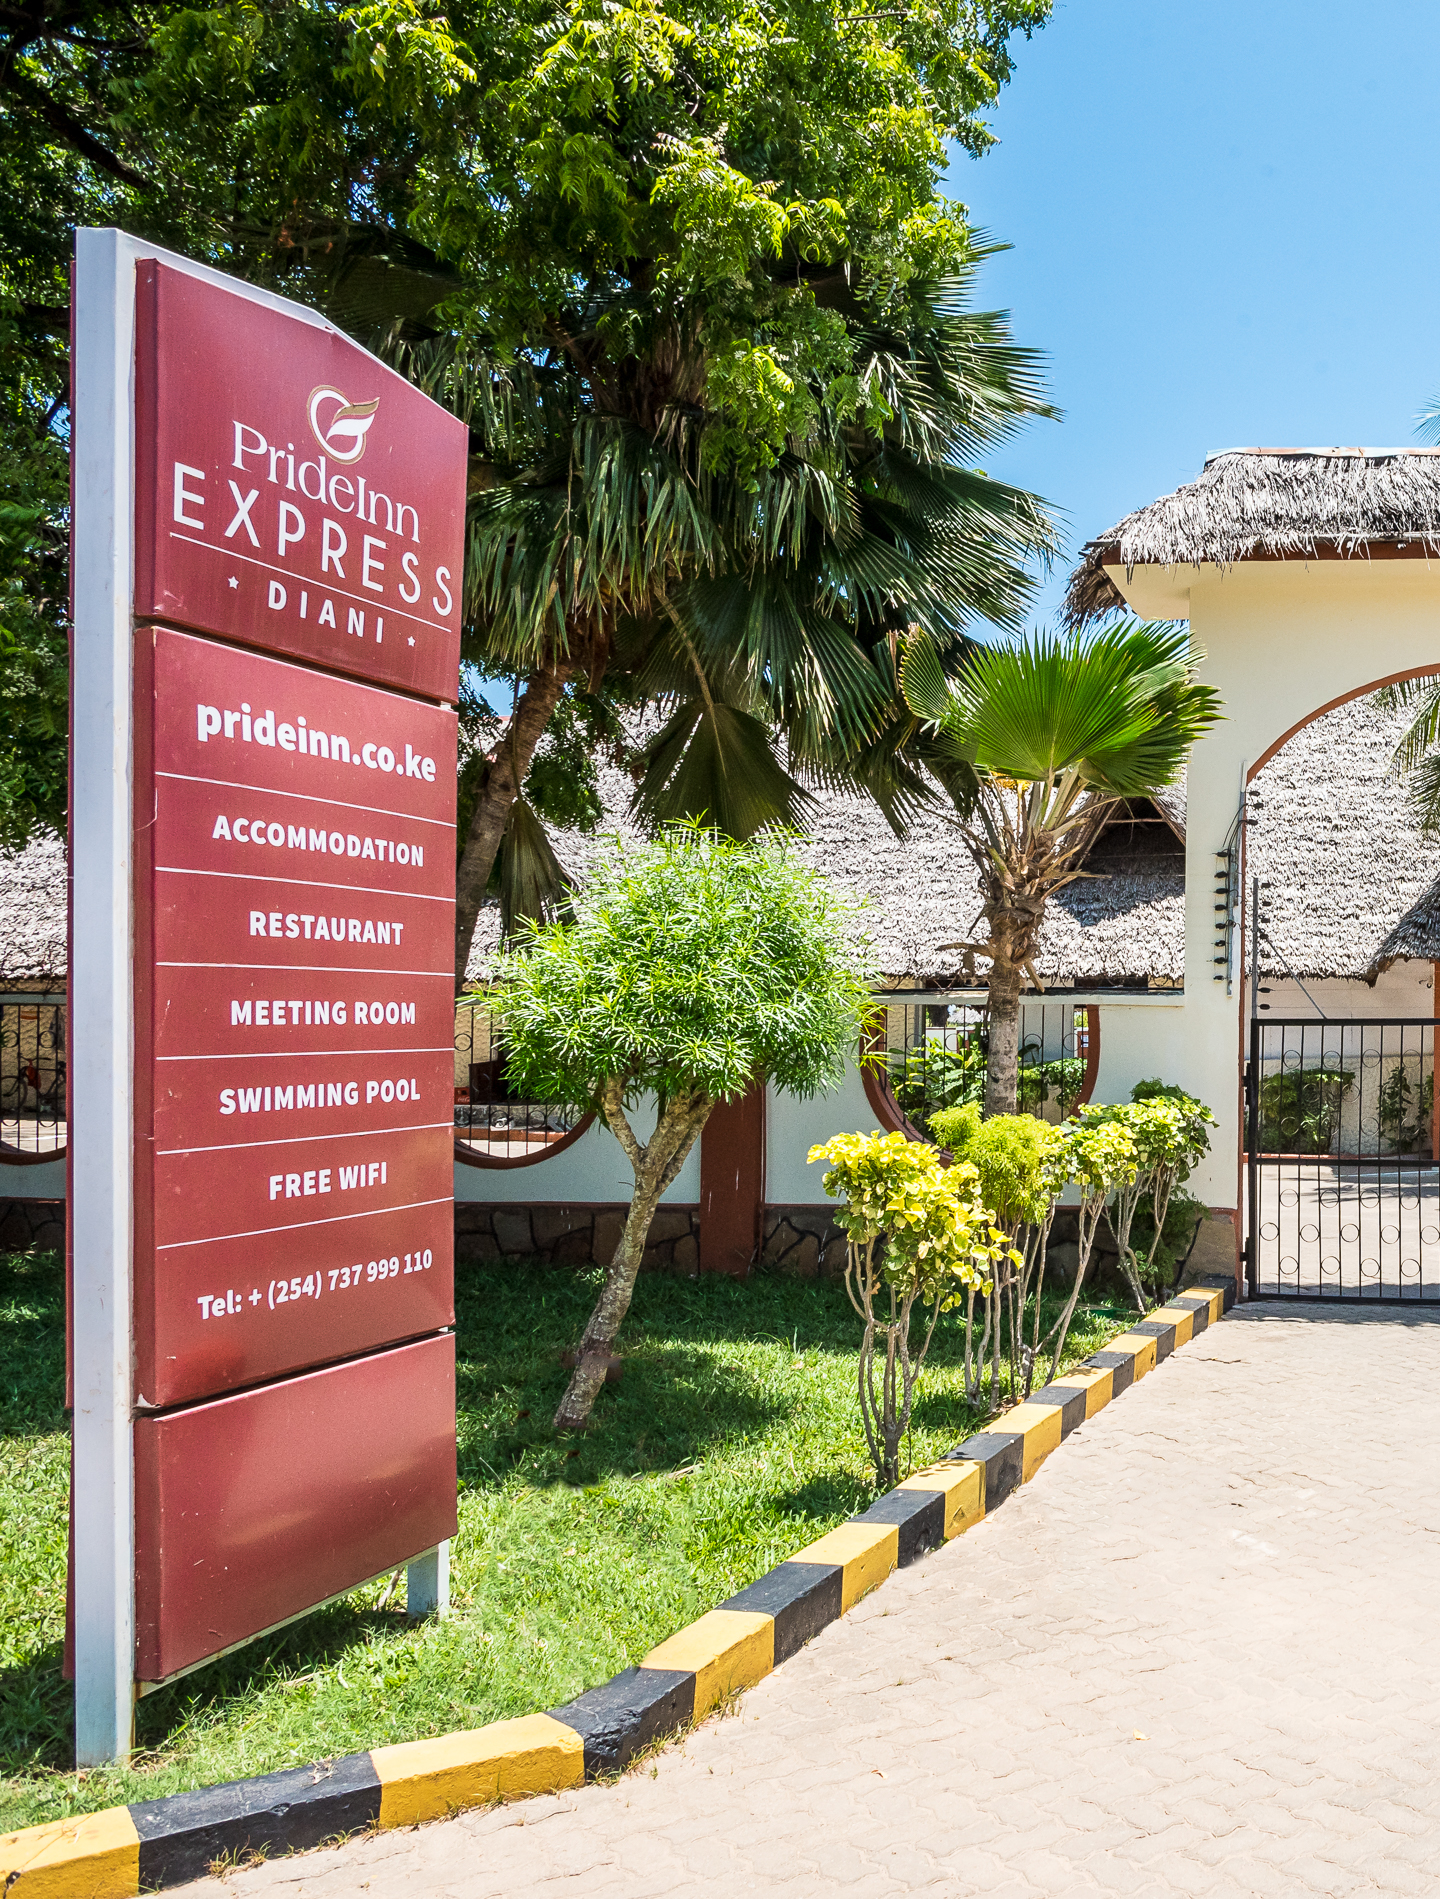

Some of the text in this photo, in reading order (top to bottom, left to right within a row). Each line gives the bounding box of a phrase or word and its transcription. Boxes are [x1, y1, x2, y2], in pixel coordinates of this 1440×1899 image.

[232, 420, 420, 543] PrideInn
[173, 461, 453, 617] EXPRESS
[268, 580, 384, 644] DIANI
[197, 703, 437, 782] prideinn.co.ke
[212, 815, 425, 867] ACCOMMODATION
[249, 911, 404, 945] RESTAURANT
[231, 1000, 416, 1026] MEETING ROOM
[219, 1079, 421, 1114] SWIMMING POOL
[269, 1161, 387, 1200] FREE WIFI
[198, 1289, 242, 1320] Tel:
[268, 1270, 322, 1309] (254)
[328, 1264, 363, 1291] 737
[366, 1257, 399, 1282] 999
[403, 1249, 433, 1273] 110
